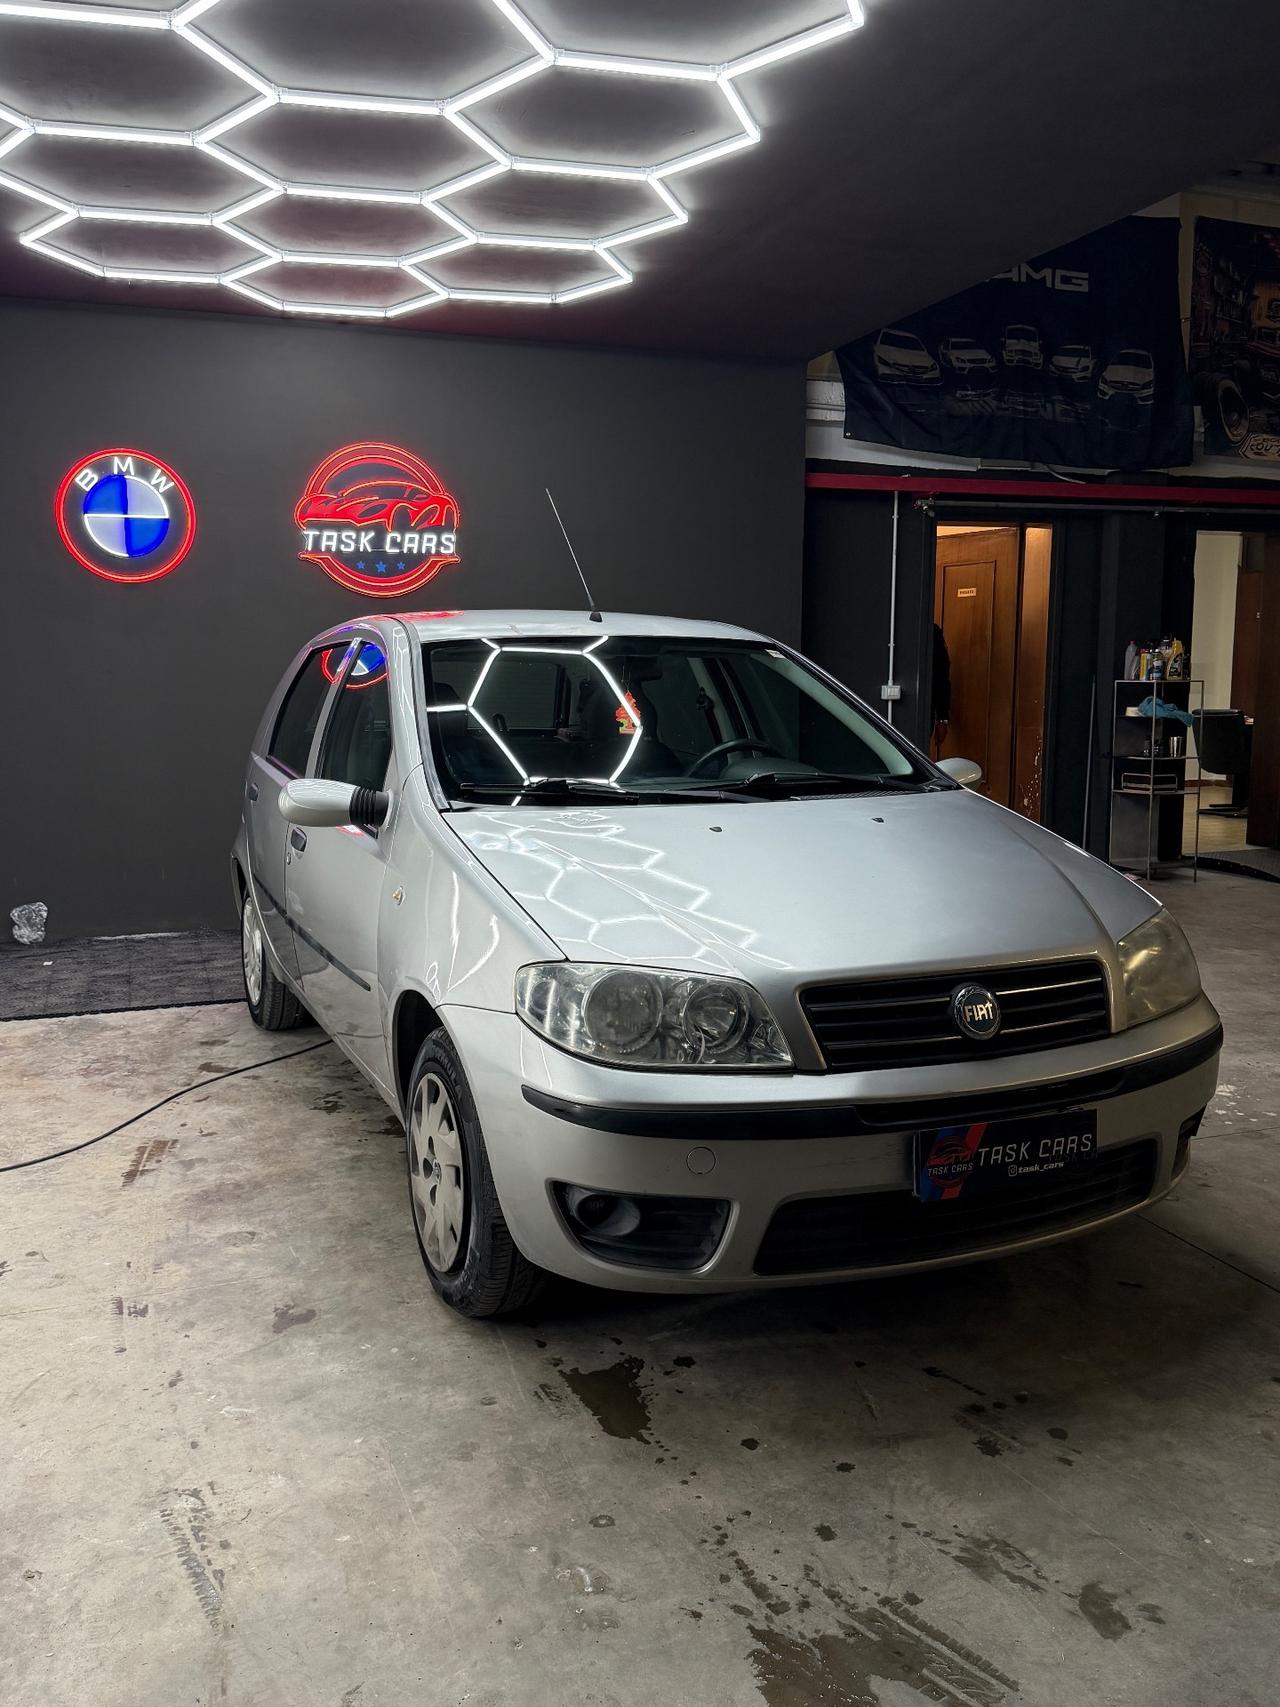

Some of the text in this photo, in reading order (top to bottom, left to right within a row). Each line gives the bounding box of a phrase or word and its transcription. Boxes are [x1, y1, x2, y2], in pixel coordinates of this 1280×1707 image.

[75, 456, 175, 493] BMW
[303, 530, 455, 554] TASK CARS
[964, 1000, 993, 1022] FIAT
[979, 1134, 1093, 1167] TASK CARS
[928, 1162, 974, 1176] TASK CARS
